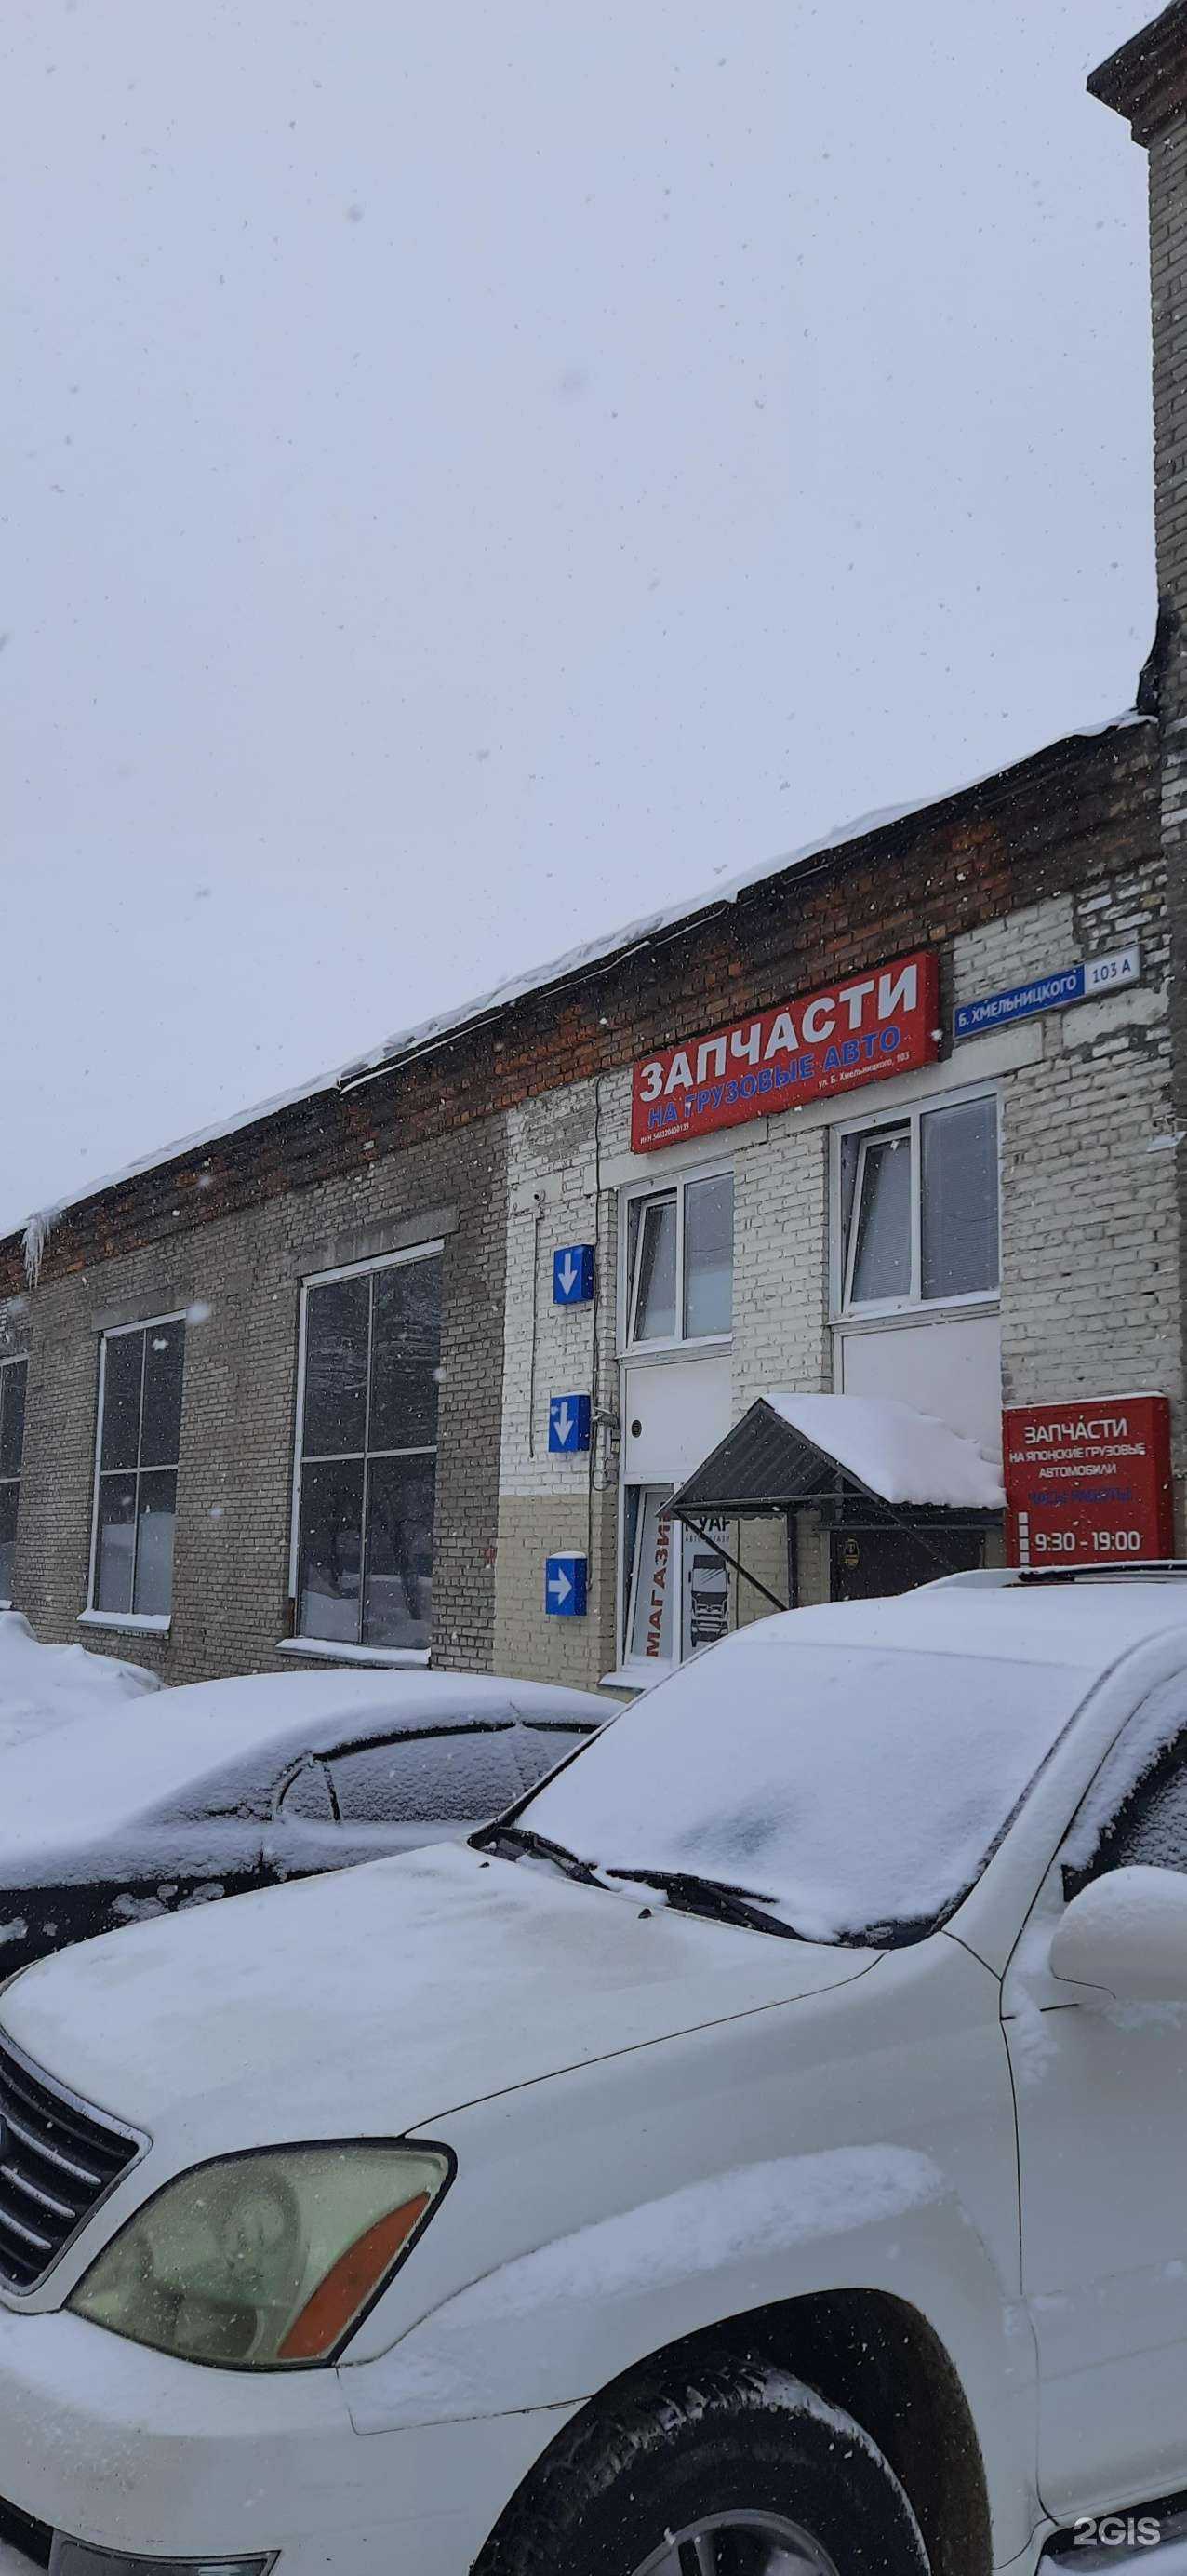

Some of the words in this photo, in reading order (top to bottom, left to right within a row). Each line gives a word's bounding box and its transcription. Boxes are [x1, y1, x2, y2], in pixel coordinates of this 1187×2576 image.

[957, 1013, 969, 1027] Б.
[971, 975, 1077, 1024] ХМЕЛЬНИЦКОГО
[1092, 962, 1117, 983] 103
[1121, 959, 1131, 974] А
[640, 964, 917, 1102] ЗАПЧАСТИ
[897, 1052, 910, 1063] 103
[647, 1102, 677, 1129] НА
[684, 1053, 815, 1117] ГРУЗОВЫЕ
[823, 1026, 901, 1073] АВТО
[1024, 1418, 1128, 1443] ЗАПЧАСТИ
[1009, 1452, 1024, 1463] НА
[1025, 1448, 1084, 1461] ЯПОНСКИЕ
[1086, 1443, 1146, 1458] ГРУЗОВЫЕ
[1038, 1464, 1117, 1478] АВТОМОБИЛИ
[1035, 1533, 1075, 1552] 9:30
[1092, 1531, 1140, 1551] 19:00
